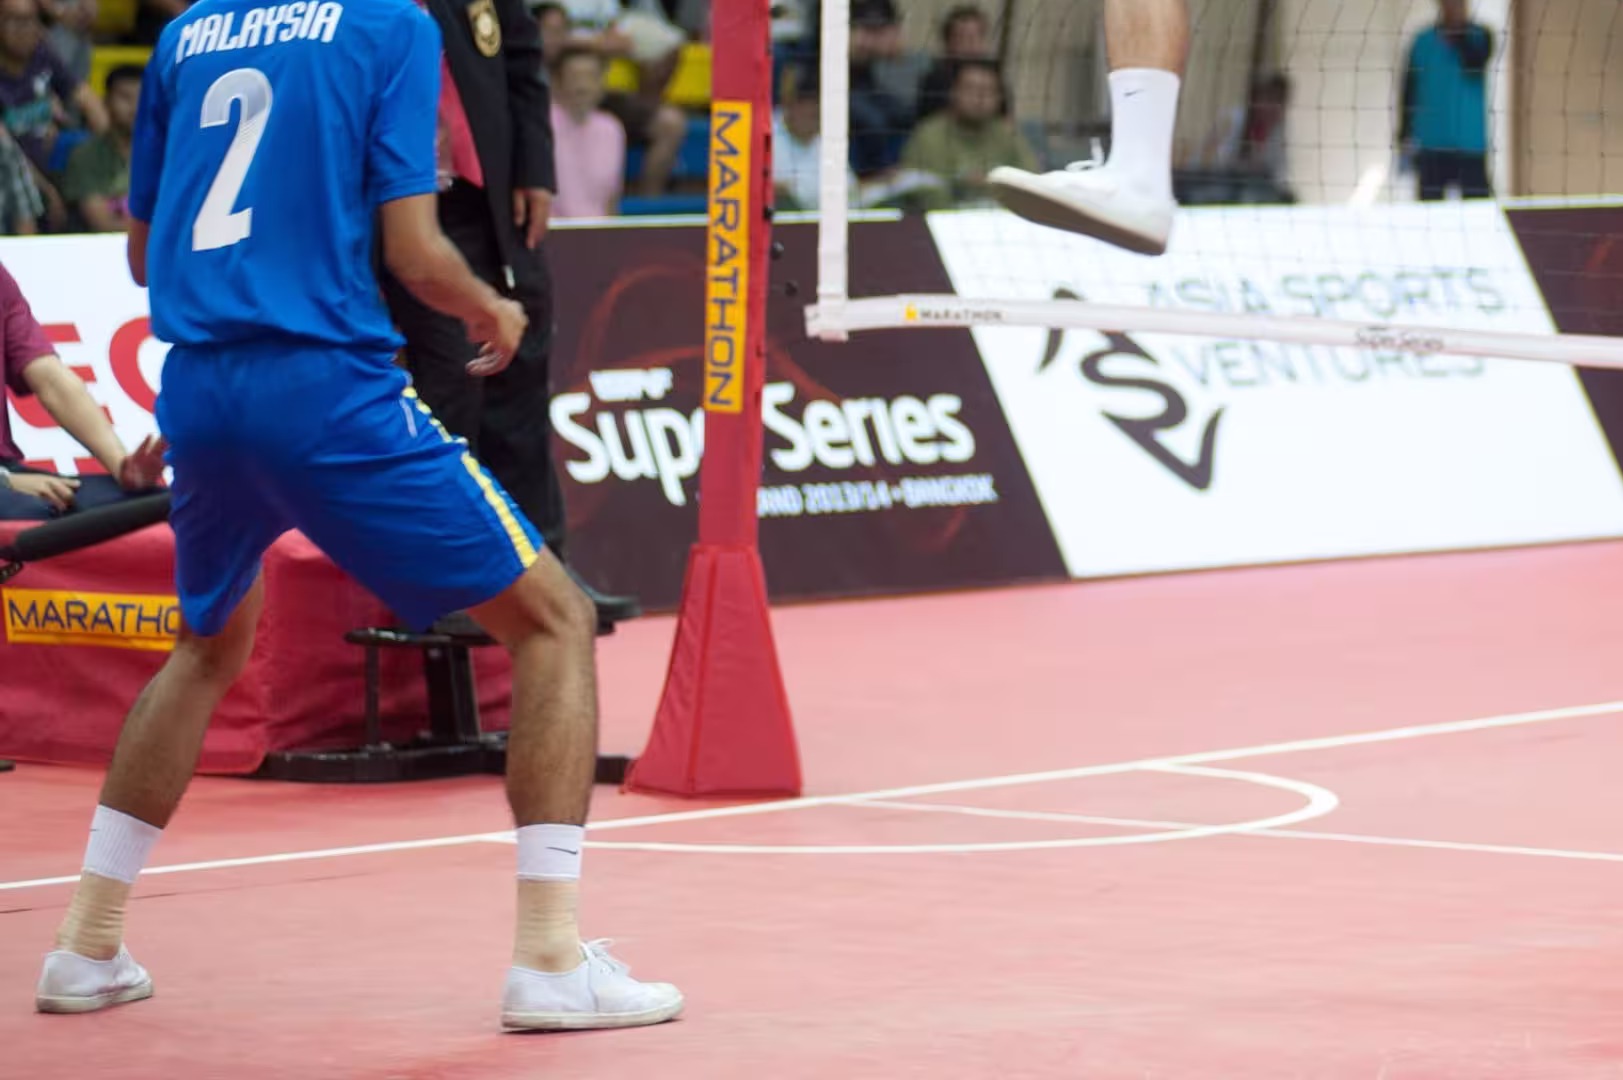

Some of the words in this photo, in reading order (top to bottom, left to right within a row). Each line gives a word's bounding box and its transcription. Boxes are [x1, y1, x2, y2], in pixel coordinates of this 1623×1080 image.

[176, 0, 343, 64] MALAYSIA
[192, 67, 274, 251] 2
[709, 110, 741, 406] MARATHON
[8, 599, 181, 634] MARATHO
